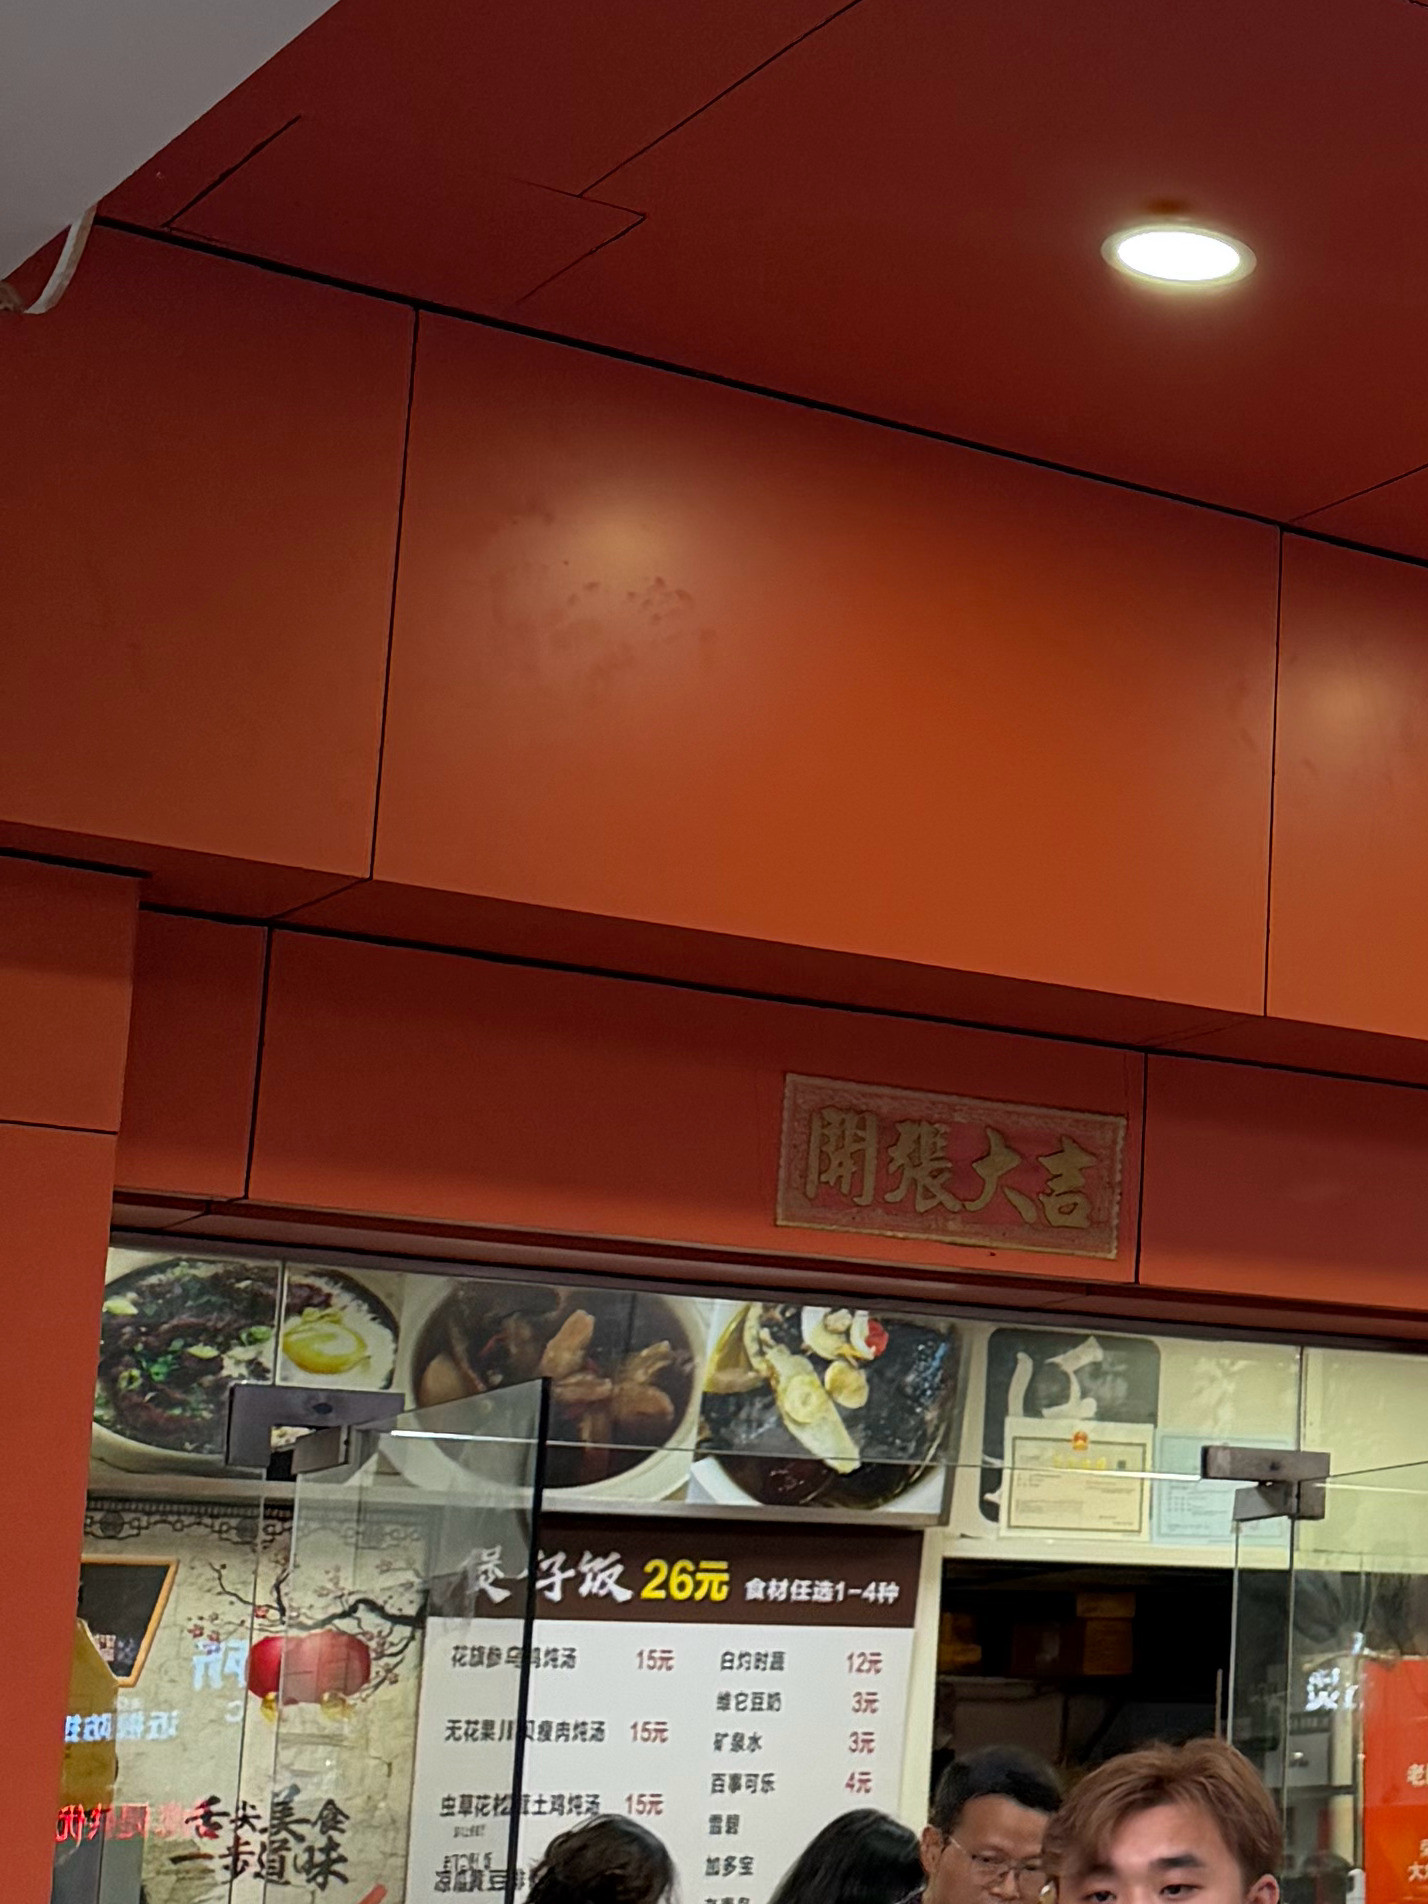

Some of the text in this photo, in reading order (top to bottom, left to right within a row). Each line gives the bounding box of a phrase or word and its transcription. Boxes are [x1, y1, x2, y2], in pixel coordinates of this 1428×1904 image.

[640, 1558, 730, 1602] 26元
[636, 1648, 675, 1672] 15元
[846, 1652, 884, 1676] 12元
[851, 1691, 880, 1714] 3元
[630, 1721, 669, 1744] 15元
[848, 1731, 876, 1754] 3元
[710, 1771, 873, 1794] 百事可乐 4元
[624, 1794, 663, 1816] 15元
